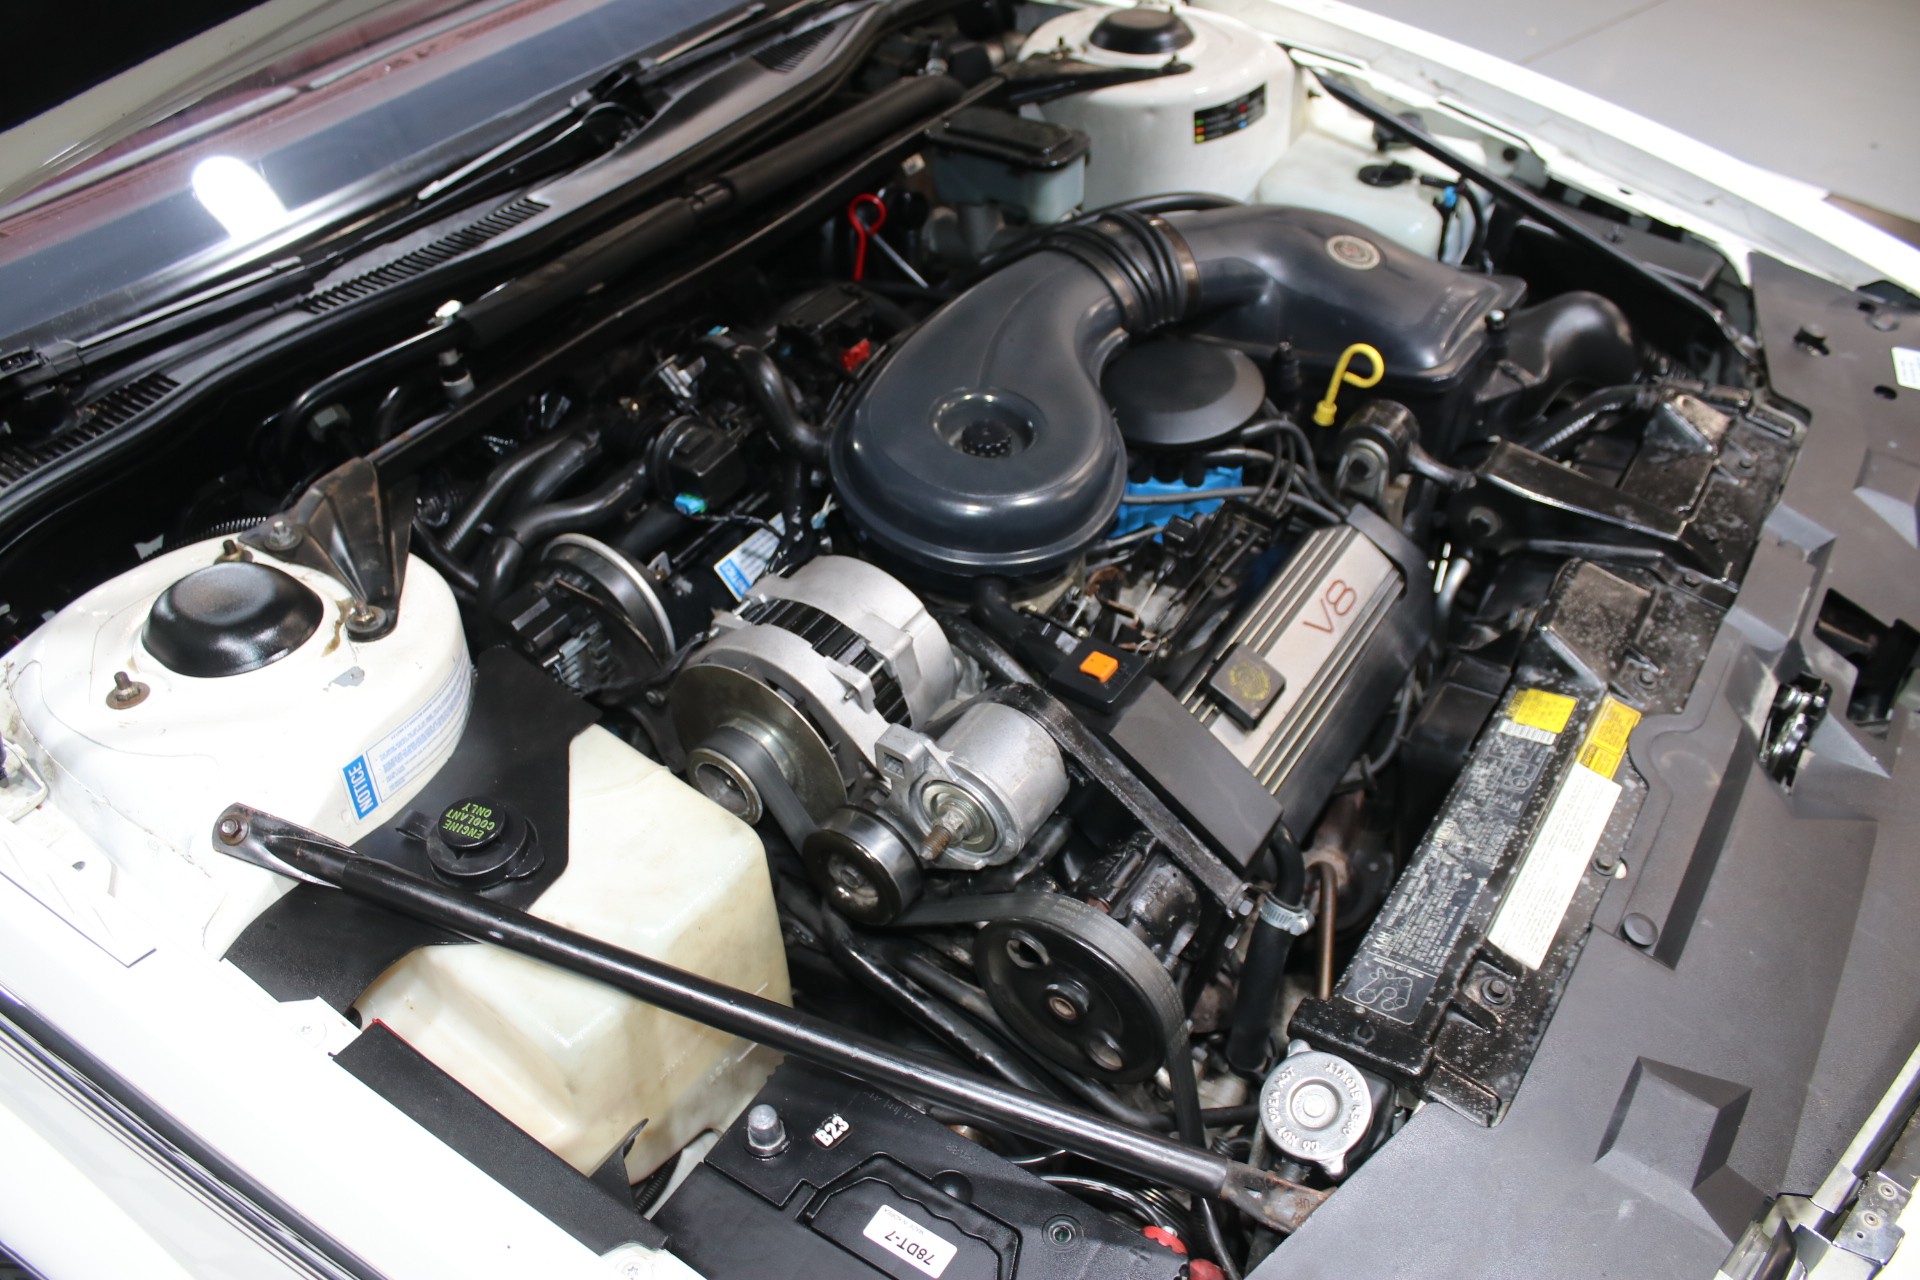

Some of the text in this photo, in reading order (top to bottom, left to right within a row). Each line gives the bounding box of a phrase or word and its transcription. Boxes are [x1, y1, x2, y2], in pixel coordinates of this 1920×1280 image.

[1303, 579, 1357, 634] V8
[348, 762, 374, 814] NOTICE
[445, 809, 496, 831] COOLANT
[461, 802, 492, 818] ONLY
[442, 819, 485, 840] ENGINE
[1267, 1090, 1281, 1123] OPEN
[814, 1115, 850, 1147] B23
[1276, 1125, 1300, 1147] NOT
[1301, 1140, 1320, 1152] DO
[884, 1230, 935, 1266] 78DT-7
